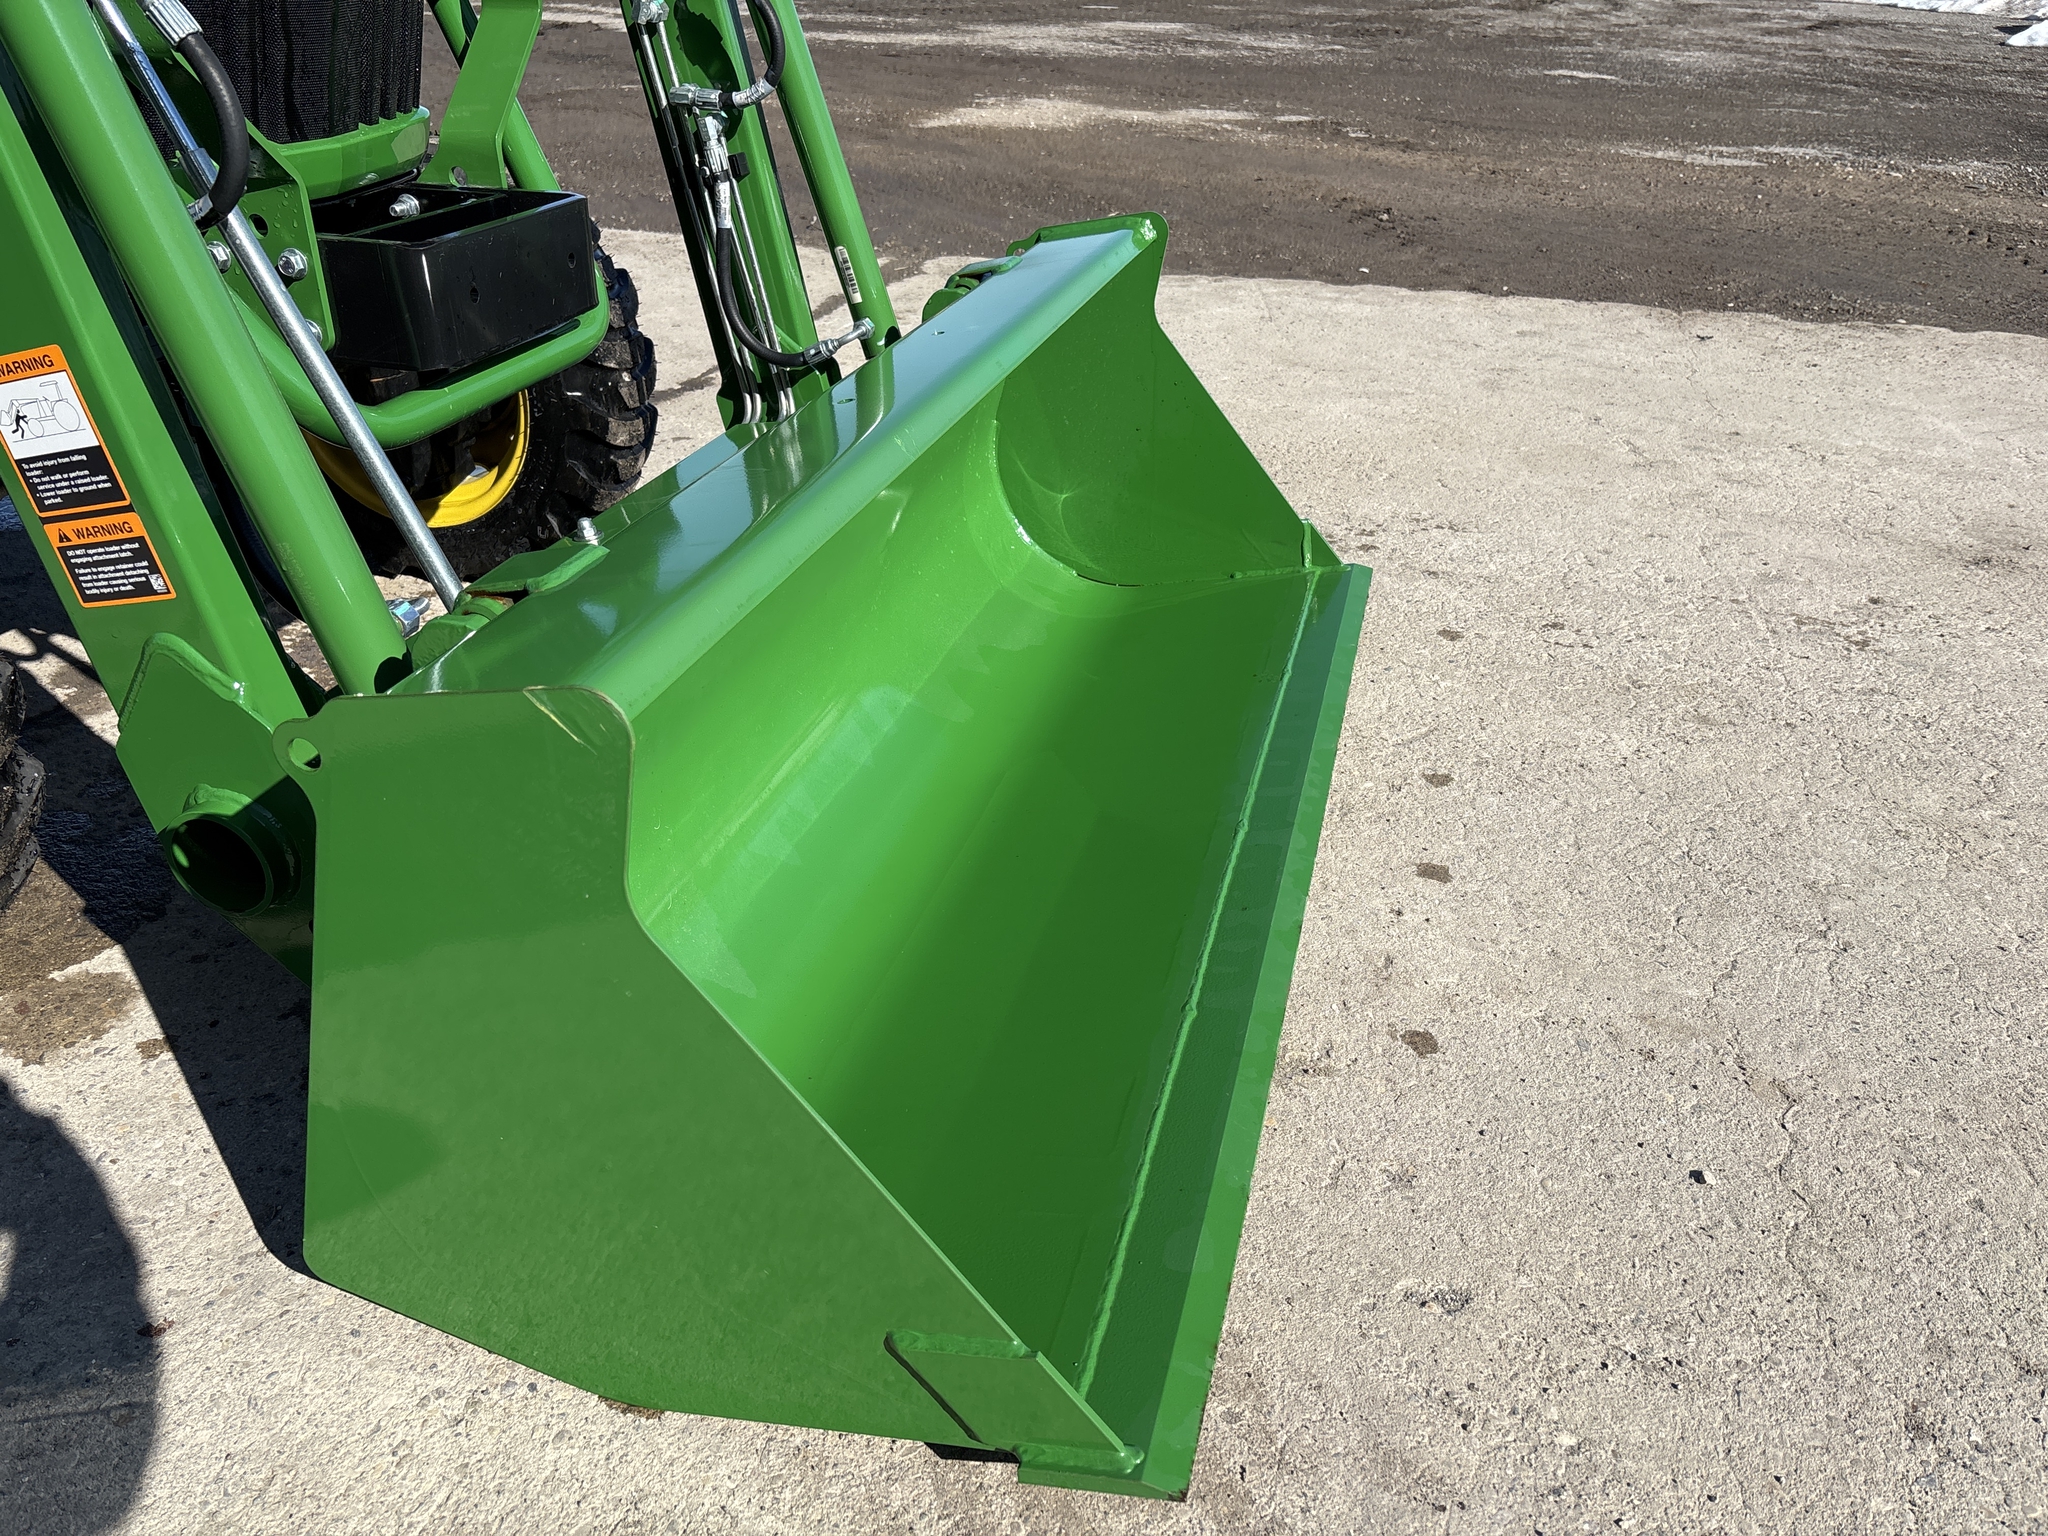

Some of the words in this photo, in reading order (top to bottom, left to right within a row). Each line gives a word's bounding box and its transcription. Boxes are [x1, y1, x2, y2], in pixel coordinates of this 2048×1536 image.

[69, 470, 90, 478] perform
[78, 484, 97, 493] ground
[72, 521, 134, 540] WARNING
[92, 553, 120, 561] attachment
[98, 571, 125, 579] attachment
